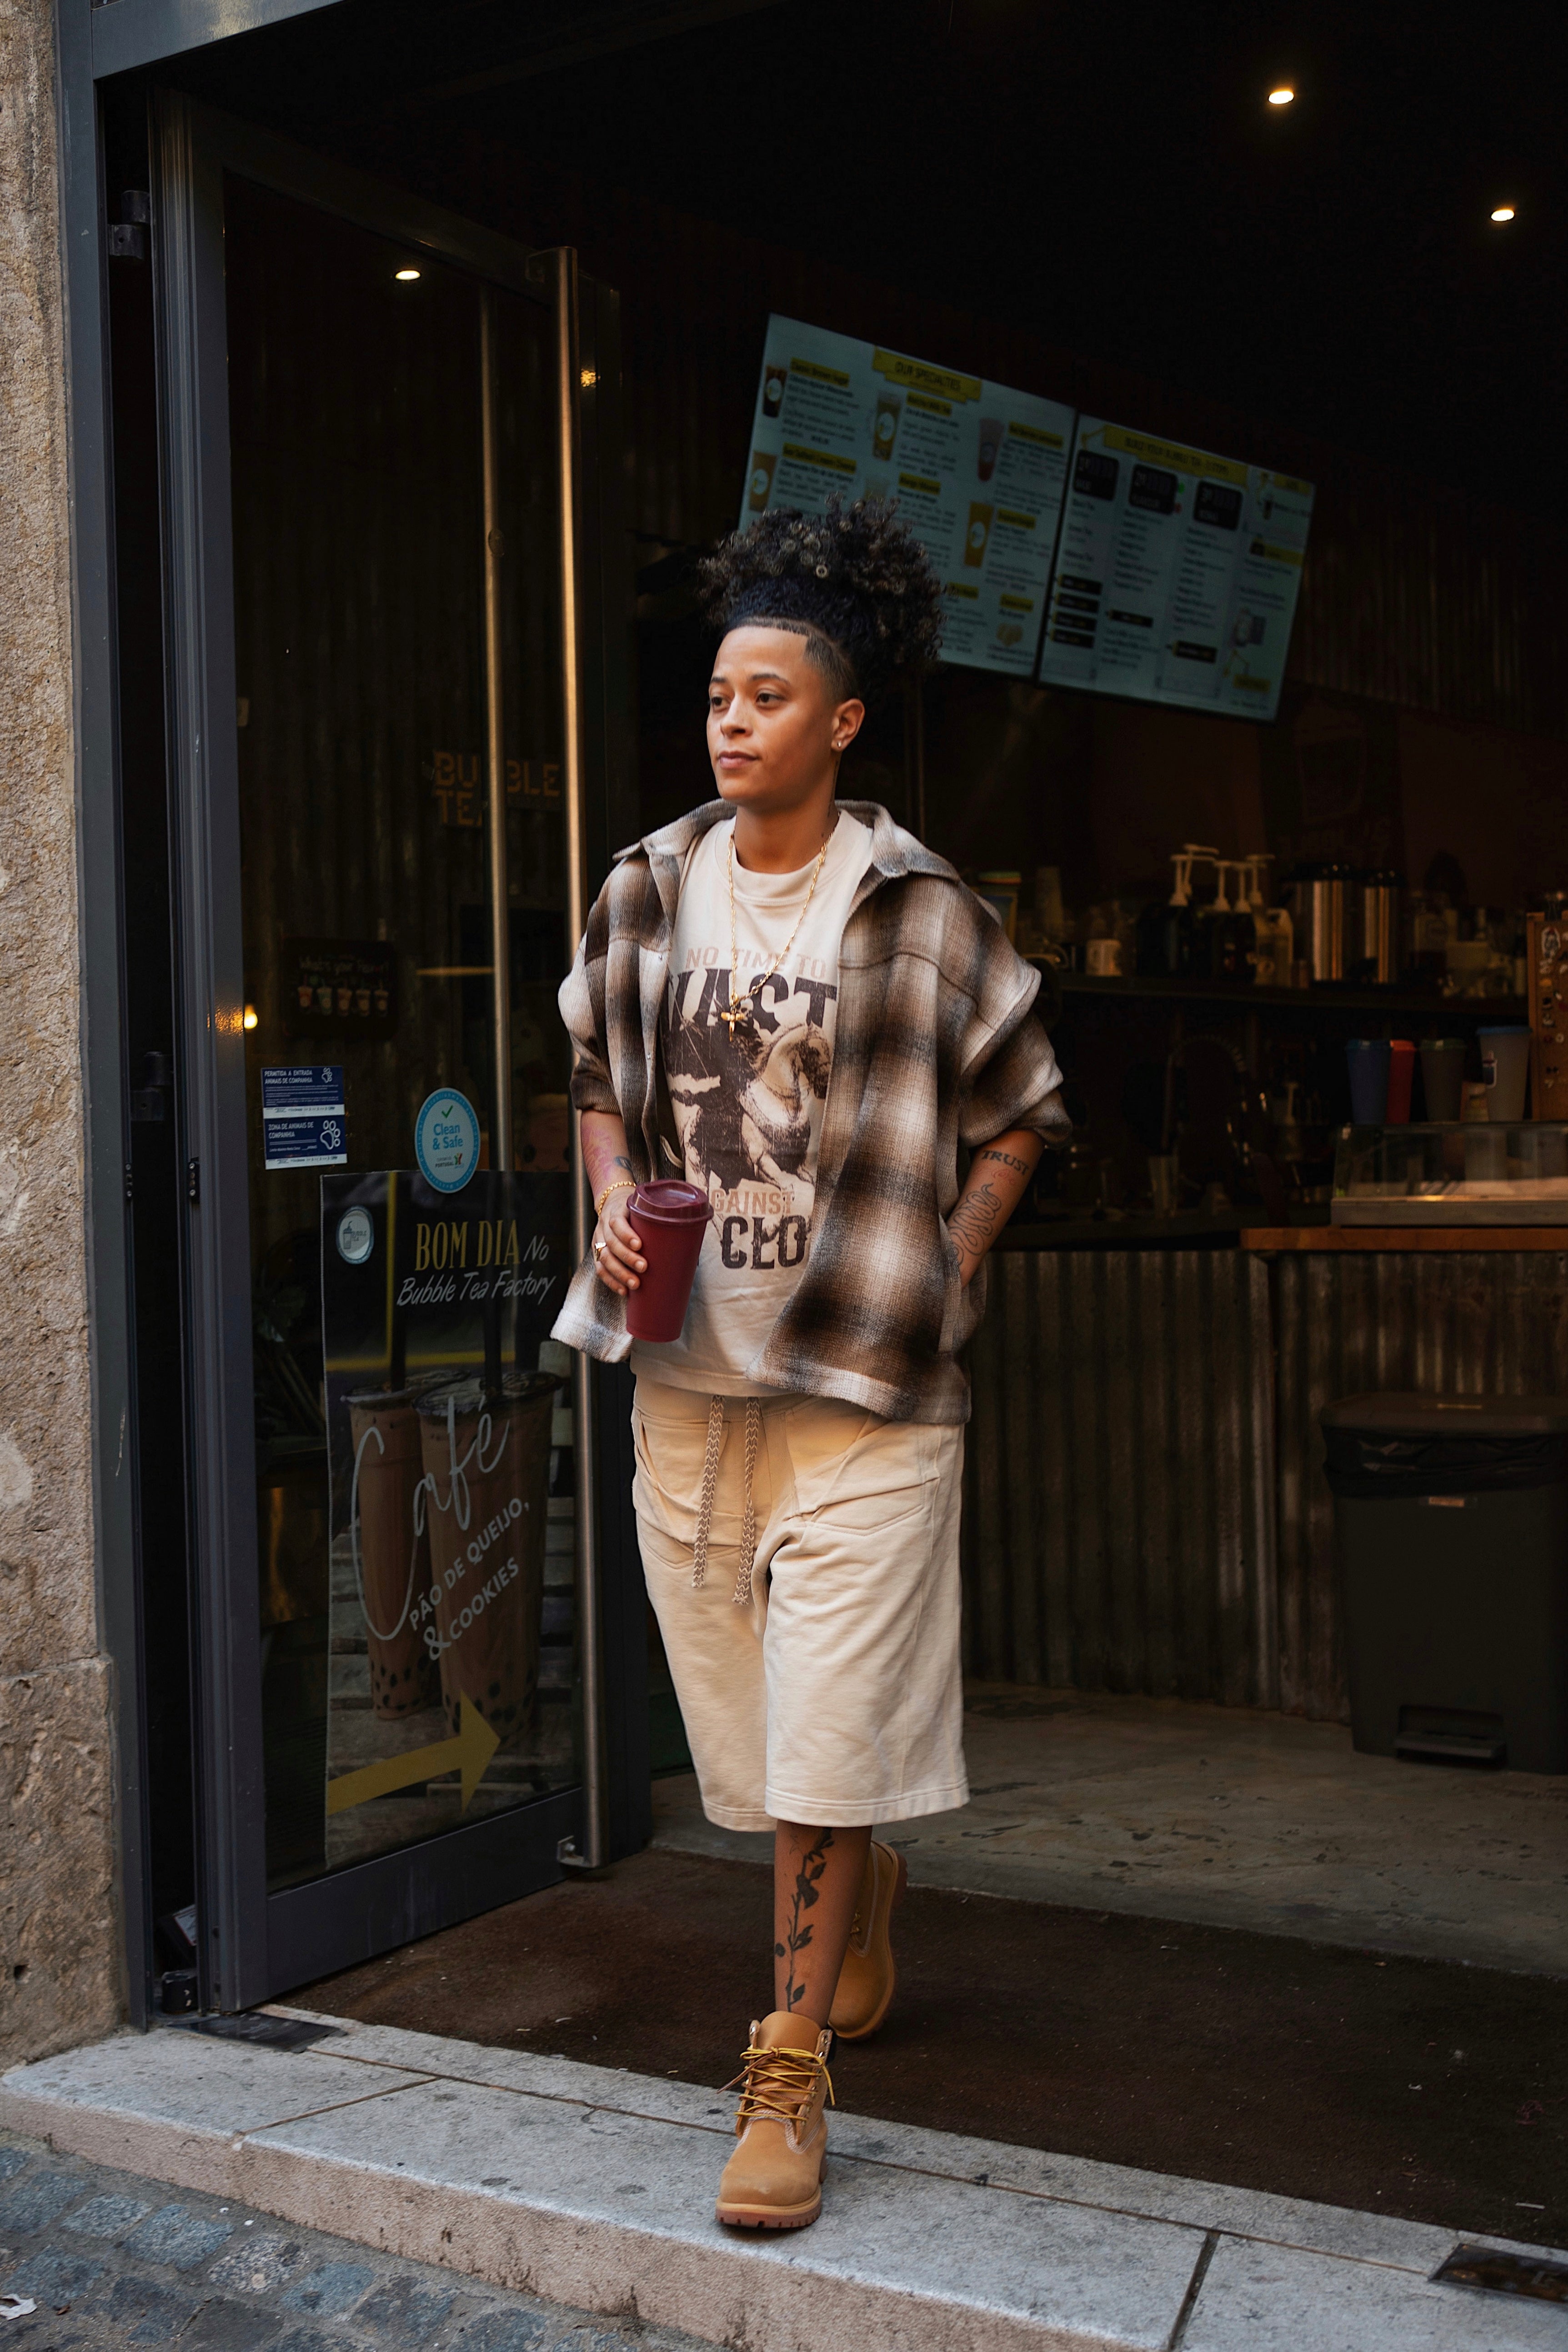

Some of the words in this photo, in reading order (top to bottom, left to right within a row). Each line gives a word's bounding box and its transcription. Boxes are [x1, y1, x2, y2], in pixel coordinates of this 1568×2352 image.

[434, 751, 561, 798] BUBLE
[433, 789, 482, 826] TE
[685, 947, 719, 969] NO
[731, 948, 788, 971] TIME
[796, 953, 826, 979] TO
[268, 1131, 296, 1139] COMPANHIA
[433, 1123, 461, 1136] Clean
[433, 1138, 440, 1150] &
[443, 1135, 463, 1149] Safe
[982, 1150, 1030, 1176] TRUST
[710, 1189, 794, 1215] GAINST
[415, 1221, 469, 1271] BOM
[476, 1220, 521, 1267] DIA
[523, 1235, 549, 1262] No
[720, 1215, 808, 1270] CLO
[396, 1274, 456, 1306] Bubble
[460, 1271, 489, 1301] Tea
[491, 1270, 556, 1306] Factory
[351, 1395, 510, 1641] Café
[409, 1585, 441, 1631] PÃO
[444, 1557, 466, 1588] DE
[467, 1498, 530, 1565] QUEIJO,
[423, 1626, 452, 1661] &
[450, 1557, 519, 1640] COOKIES
